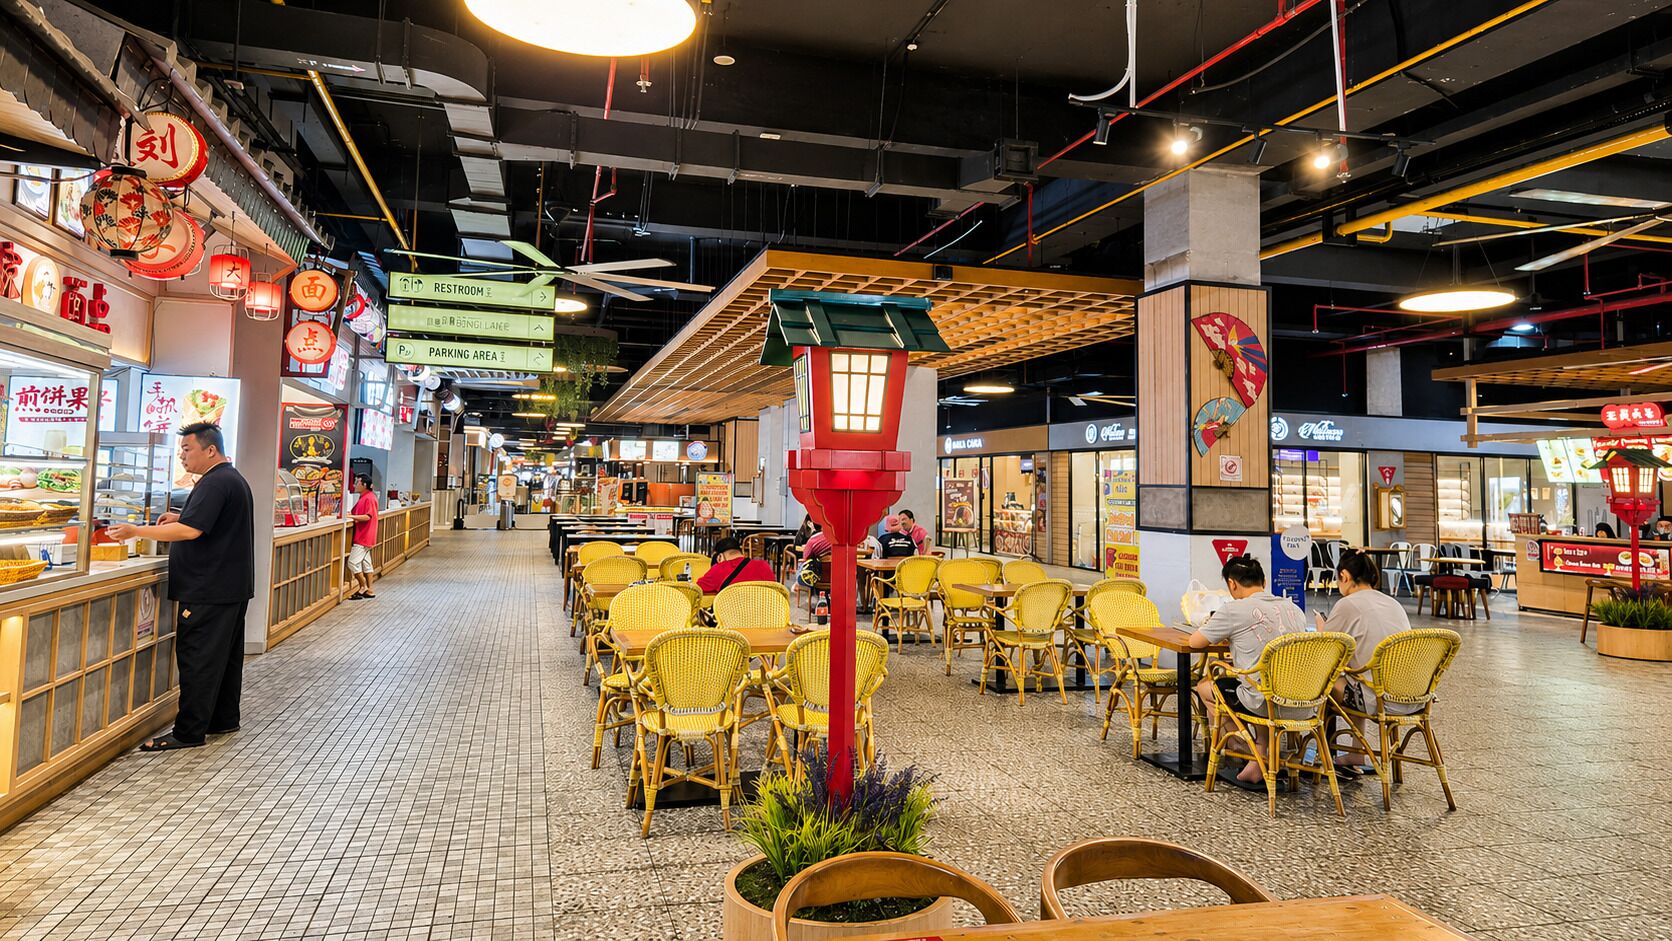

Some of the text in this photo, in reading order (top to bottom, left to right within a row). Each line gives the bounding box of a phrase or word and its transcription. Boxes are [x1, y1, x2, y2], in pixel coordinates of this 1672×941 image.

[136, 123, 179, 169] 刘
[226, 262, 241, 281] 大
[301, 276, 327, 301] 面
[435, 282, 484, 296] RESTROOM
[297, 327, 324, 353] 点
[429, 346, 470, 360] PARKING
[472, 350, 498, 361] AREA
